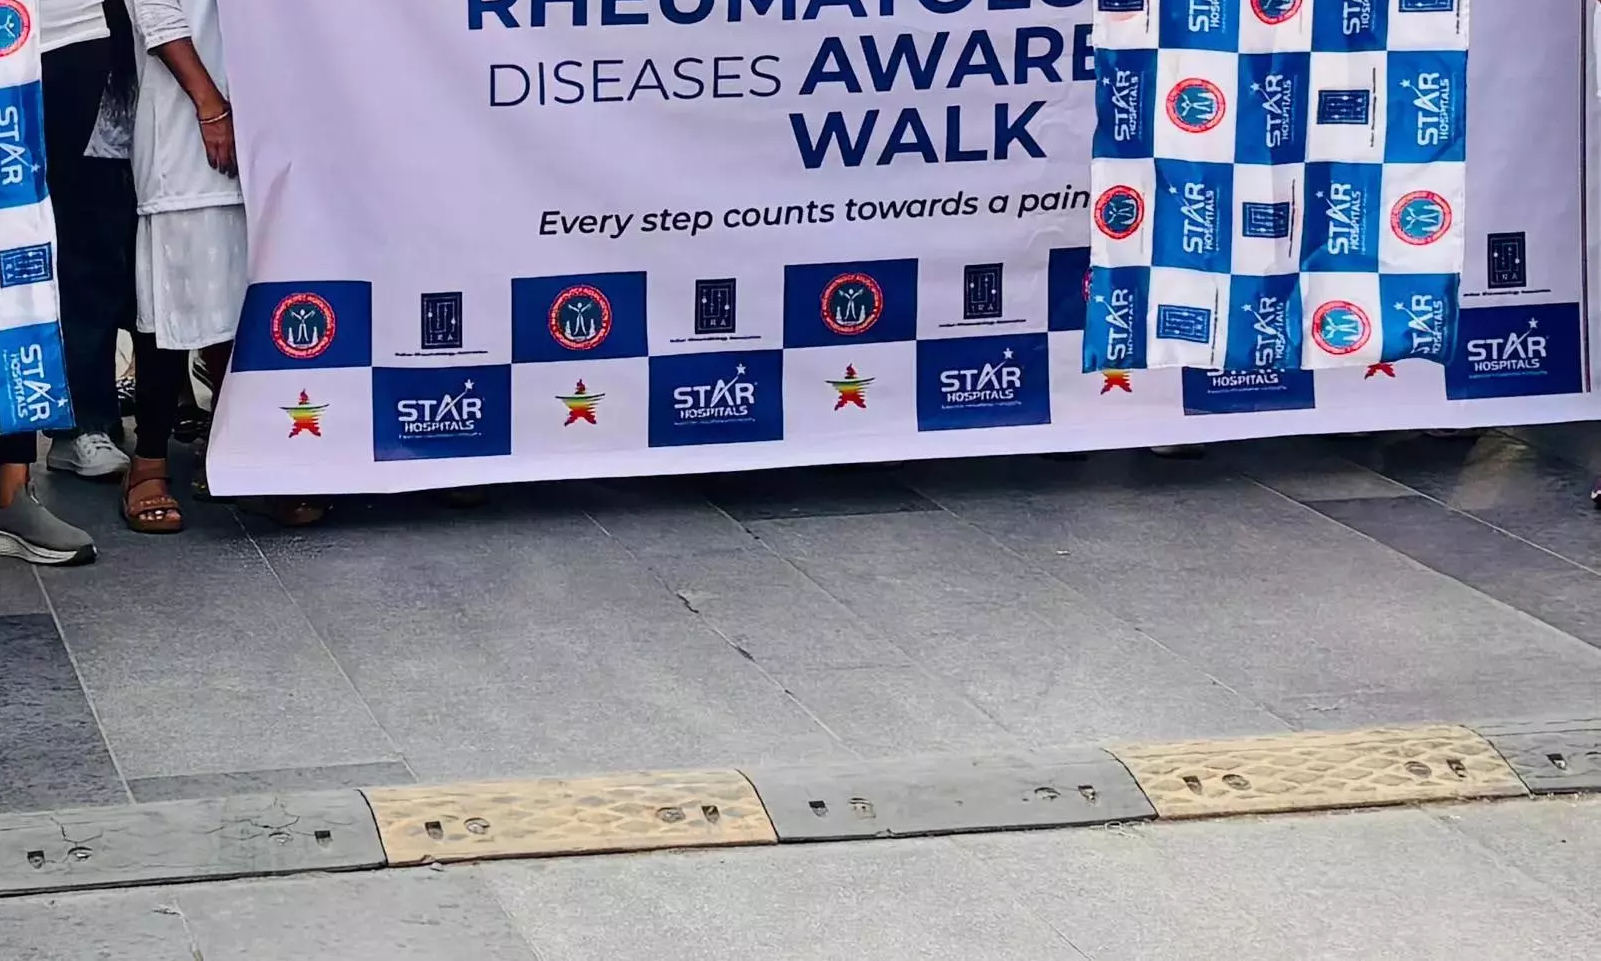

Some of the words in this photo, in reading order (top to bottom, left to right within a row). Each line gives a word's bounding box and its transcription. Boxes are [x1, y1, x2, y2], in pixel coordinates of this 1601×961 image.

[488, 55, 783, 108] DISEASES
[799, 23, 1097, 97] AWARE
[789, 100, 1048, 169] WALK
[1111, 70, 1131, 141] STAR
[1262, 74, 1284, 148] STAR
[1413, 72, 1440, 146] STAR
[539, 209, 633, 239] Every
[640, 205, 714, 234] step
[723, 200, 836, 229] counts
[844, 189, 979, 223] towards
[987, 194, 1008, 215] a
[1017, 184, 1091, 218] pain
[1181, 182, 1206, 254] STAR
[1325, 182, 1352, 255] STAR
[1105, 289, 1132, 360] STAR
[1254, 296, 1279, 368] STAR
[1467, 332, 1547, 361] STAR
[10, 353, 29, 418] HOSPITALS
[20, 344, 52, 422] STAR
[674, 379, 755, 409] STAR
[940, 363, 1021, 392] STAR
[947, 389, 1014, 402] HOSPITALS
[1212, 373, 1279, 386] HOSPITALS
[1474, 358, 1540, 371] HOSPITALS
[398, 394, 482, 421] STAR
[404, 420, 475, 432] HOSPITALS
[680, 405, 749, 419] HOSPITALS
